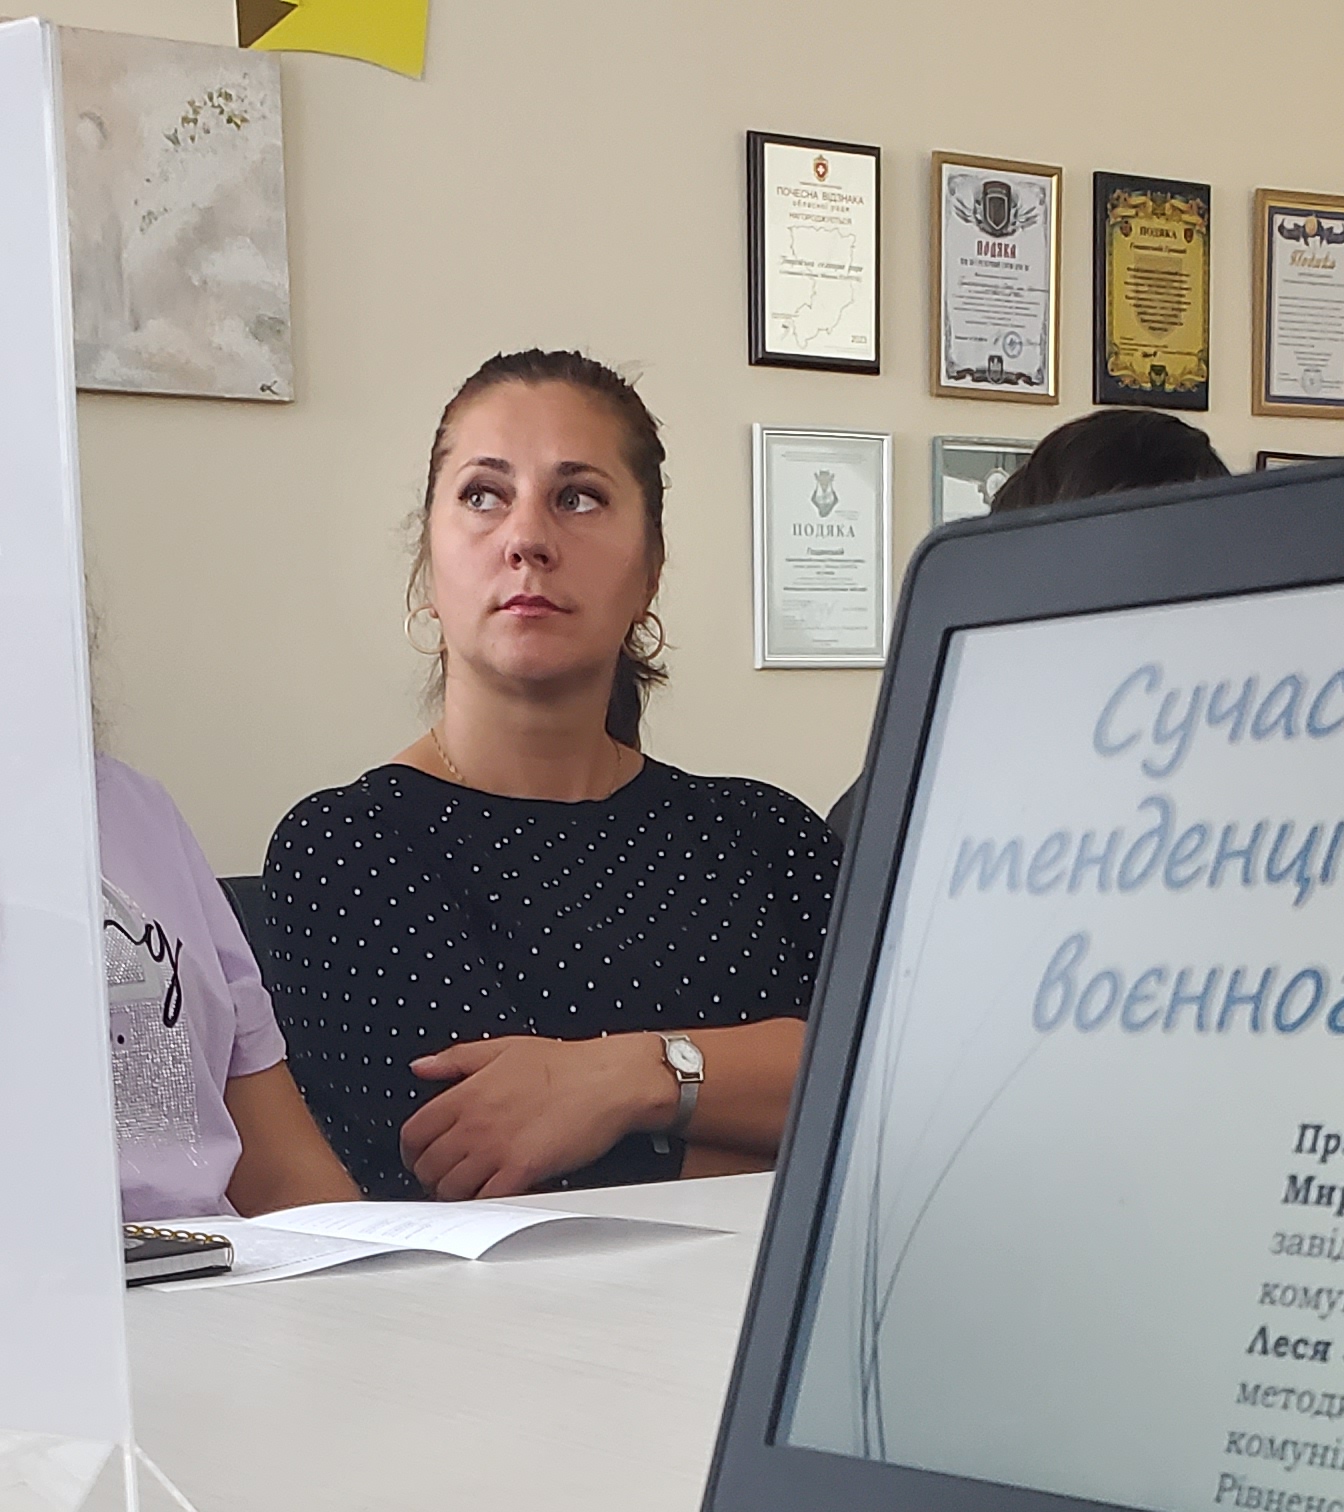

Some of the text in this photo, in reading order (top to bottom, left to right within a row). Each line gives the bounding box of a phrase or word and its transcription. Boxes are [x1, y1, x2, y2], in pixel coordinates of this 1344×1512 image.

[1139, 226, 1178, 240] ПОДЯКА
[977, 240, 1016, 259] ПОДЯКА
[792, 523, 855, 538] ПОДЯКА
[1246, 1325, 1332, 1364] Леся
